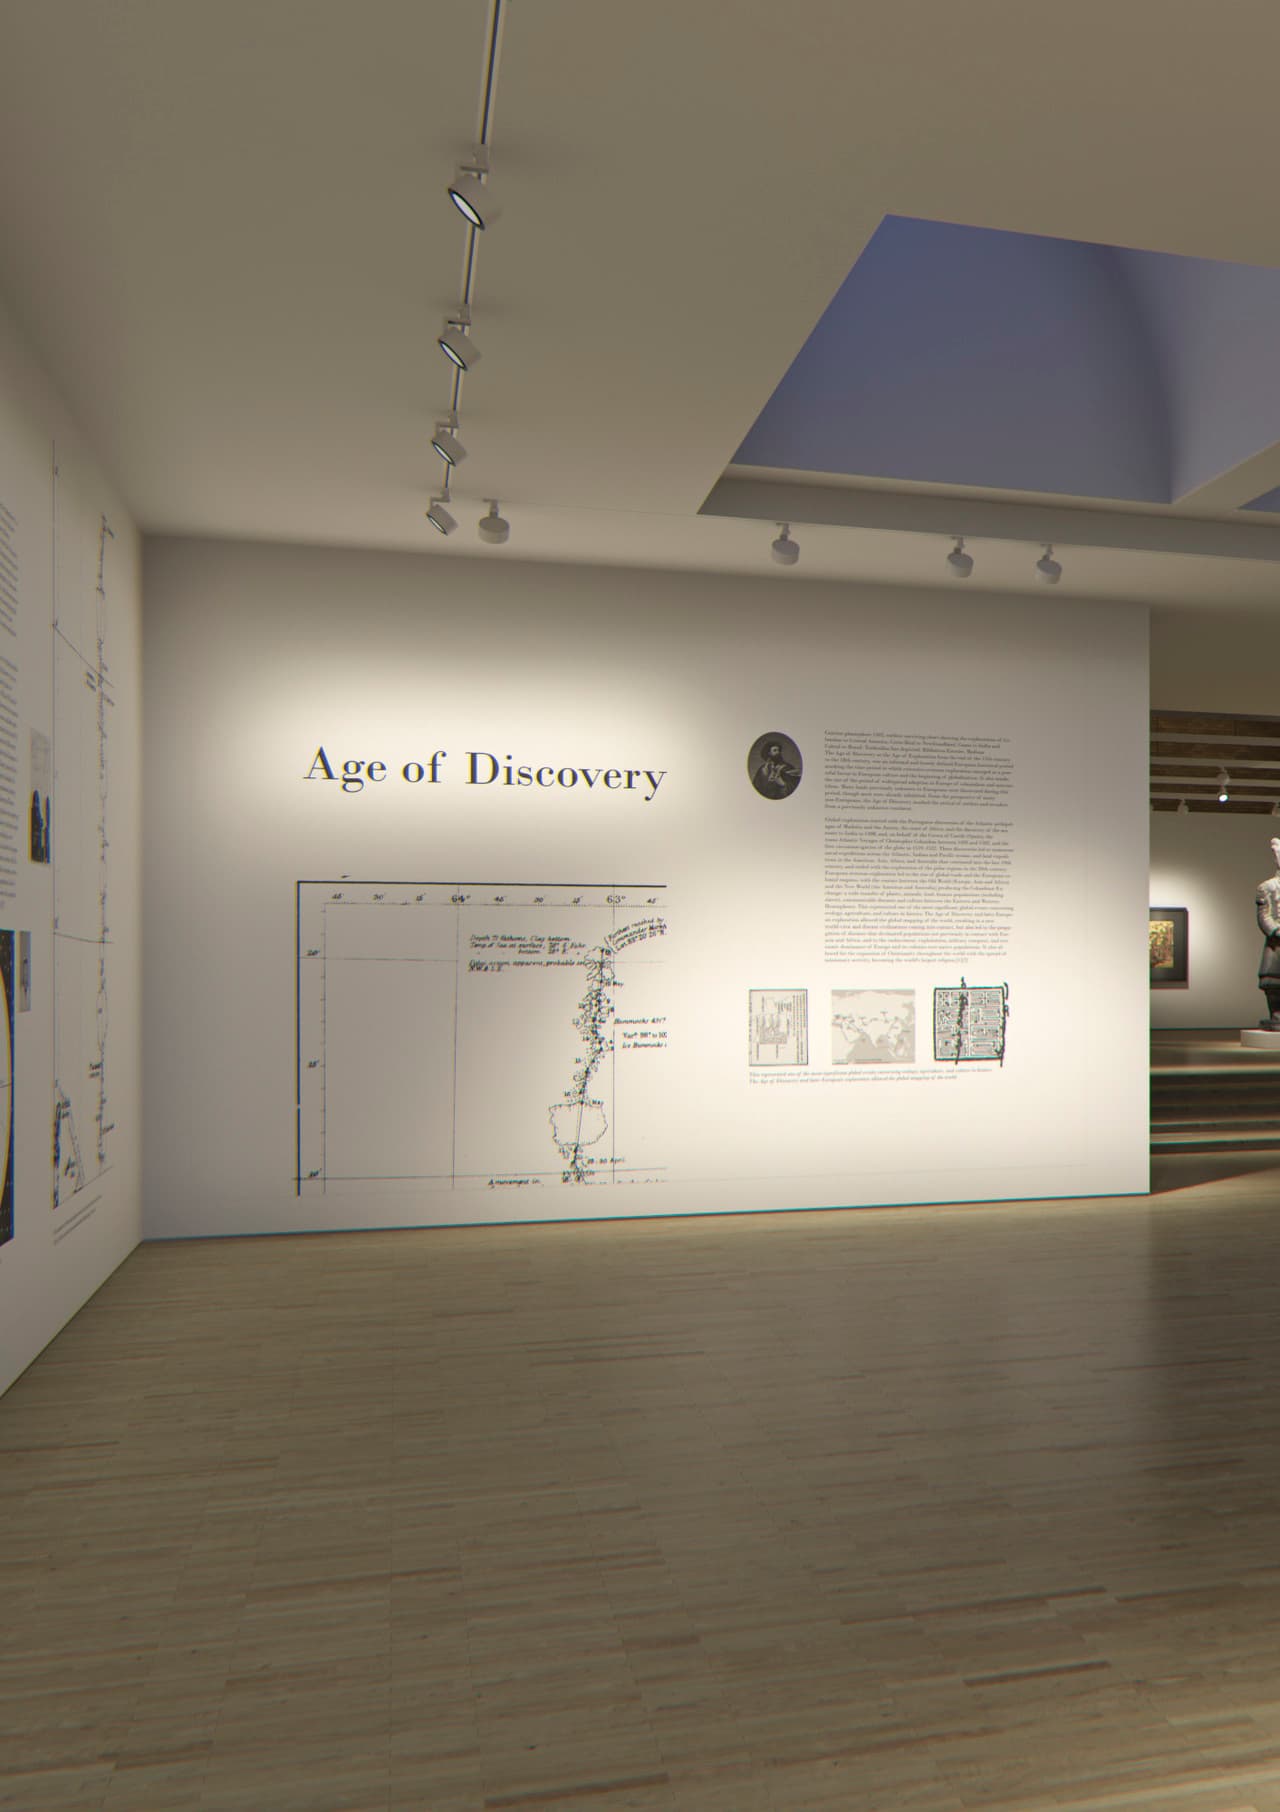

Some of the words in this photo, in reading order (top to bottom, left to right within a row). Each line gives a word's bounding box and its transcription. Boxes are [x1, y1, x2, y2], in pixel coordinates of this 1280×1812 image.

[303, 745, 387, 793] Age
[402, 750, 447, 784] of
[465, 752, 668, 801] Discovery
